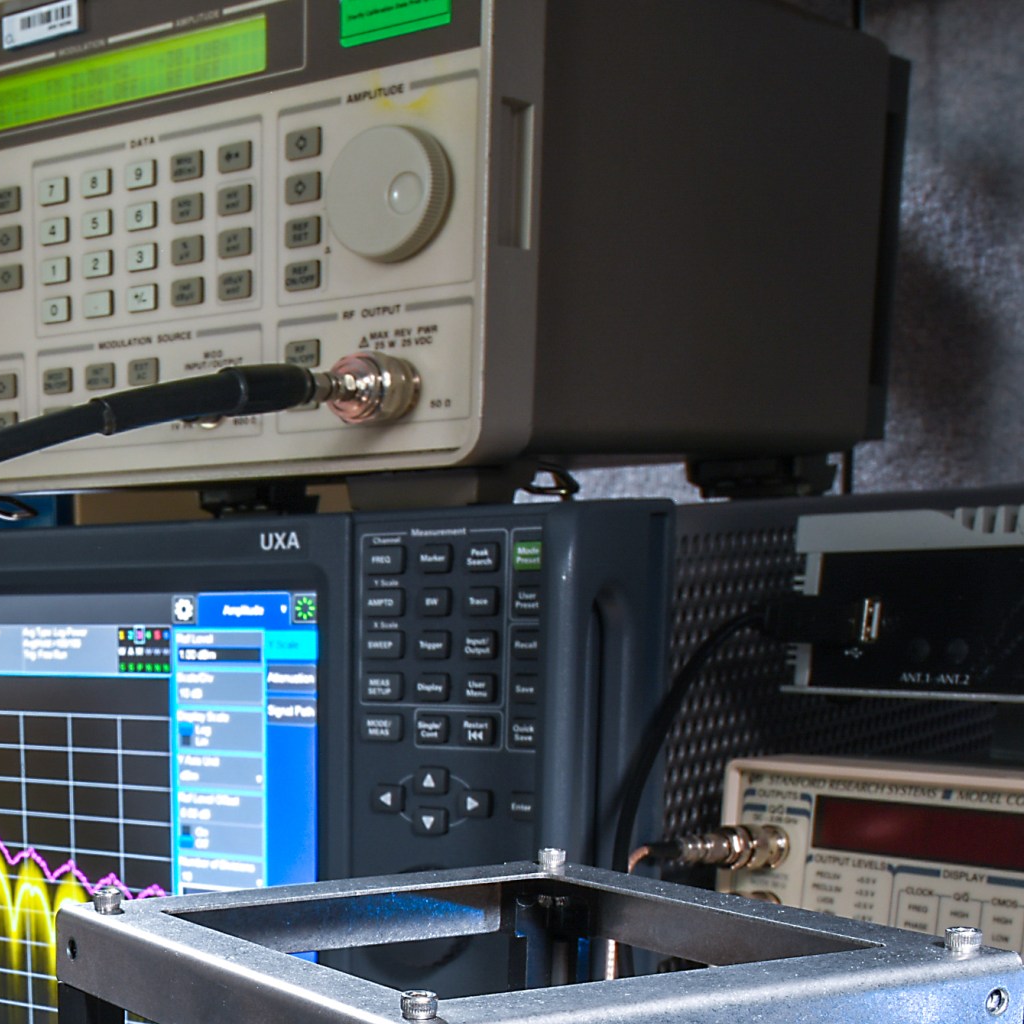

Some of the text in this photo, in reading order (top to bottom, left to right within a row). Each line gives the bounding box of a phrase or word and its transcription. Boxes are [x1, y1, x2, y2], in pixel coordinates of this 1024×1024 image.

[346, 83, 406, 104] AMPLITUDE
[130, 136, 156, 150] DATA
[134, 167, 144, 181] 9
[90, 176, 99, 190] 8
[48, 184, 56, 198] 7
[135, 210, 144, 224] 6
[91, 217, 99, 230] 5
[292, 222, 309, 232] REF
[48, 225, 57, 238] 4
[292, 232, 309, 242] SET
[136, 251, 145, 264] 3
[92, 258, 100, 271] 2
[51, 265, 56, 277] 1
[292, 266, 308, 275] REF
[285, 275, 315, 287] ON/OFF
[50, 304, 58, 317] 0
[342, 305, 401, 320] RF OUTPUT
[370, 325, 438, 341] MAX REV PWR
[98, 331, 192, 350] MODULATION SOURCE
[388, 340, 396, 349] W
[414, 336, 433, 346] VDC
[203, 350, 223, 360] MOD
[410, 527, 467, 538] Measurement
[260, 532, 301, 551] UXA
[372, 536, 402, 545] Channel
[470, 548, 489, 557] Peak
[517, 546, 540, 556] Mode
[371, 555, 392, 565] FREQ
[419, 553, 446, 563] Marker
[466, 557, 493, 567] Search
[515, 556, 541, 565] Preset
[380, 578, 399, 587] Scale
[518, 591, 536, 601] User
[367, 598, 394, 607] AMPTD
[425, 597, 439, 607] BW
[469, 597, 489, 606] Trace
[515, 600, 539, 610] Preset
[221, 604, 266, 618] Amplitude
[380, 621, 399, 630] Scale
[191, 633, 215, 645] Level
[465, 637, 490, 647] Input/
[367, 640, 393, 650] SWEEP
[419, 640, 444, 650] Trigger
[514, 640, 538, 650] Recall
[464, 646, 490, 656] Output
[266, 671, 316, 684] Attenuation
[368, 678, 391, 687] MEAS
[416, 683, 443, 693] Display
[467, 680, 486, 689] User
[514, 685, 535, 694] Save
[367, 687, 392, 696] SETUP
[465, 689, 488, 698] Menu
[266, 704, 316, 719] Signal Path
[366, 719, 392, 728] MODE/
[416, 721, 443, 732] Single/
[462, 720, 489, 730] Restart
[368, 728, 390, 737] MEAS
[512, 724, 535, 734] Quick
[420, 730, 439, 739] Cont
[513, 733, 533, 742] Save
[758, 788, 799, 800] OUTPUTS
[769, 774, 1003, 805] STANFORD RESEARCH SYSTEMS MODEL
[510, 802, 532, 812] Enter
[814, 853, 888, 871] OUTPUT LEVELS
[942, 867, 986, 883] DISPLAY
[904, 886, 934, 897] CLOCK
[991, 896, 1019, 909] CMOS
[907, 903, 928, 914] FREQ
[949, 910, 970, 919] HIGH
[992, 916, 1013, 925] HIGH
[991, 934, 1010, 943] LOW
